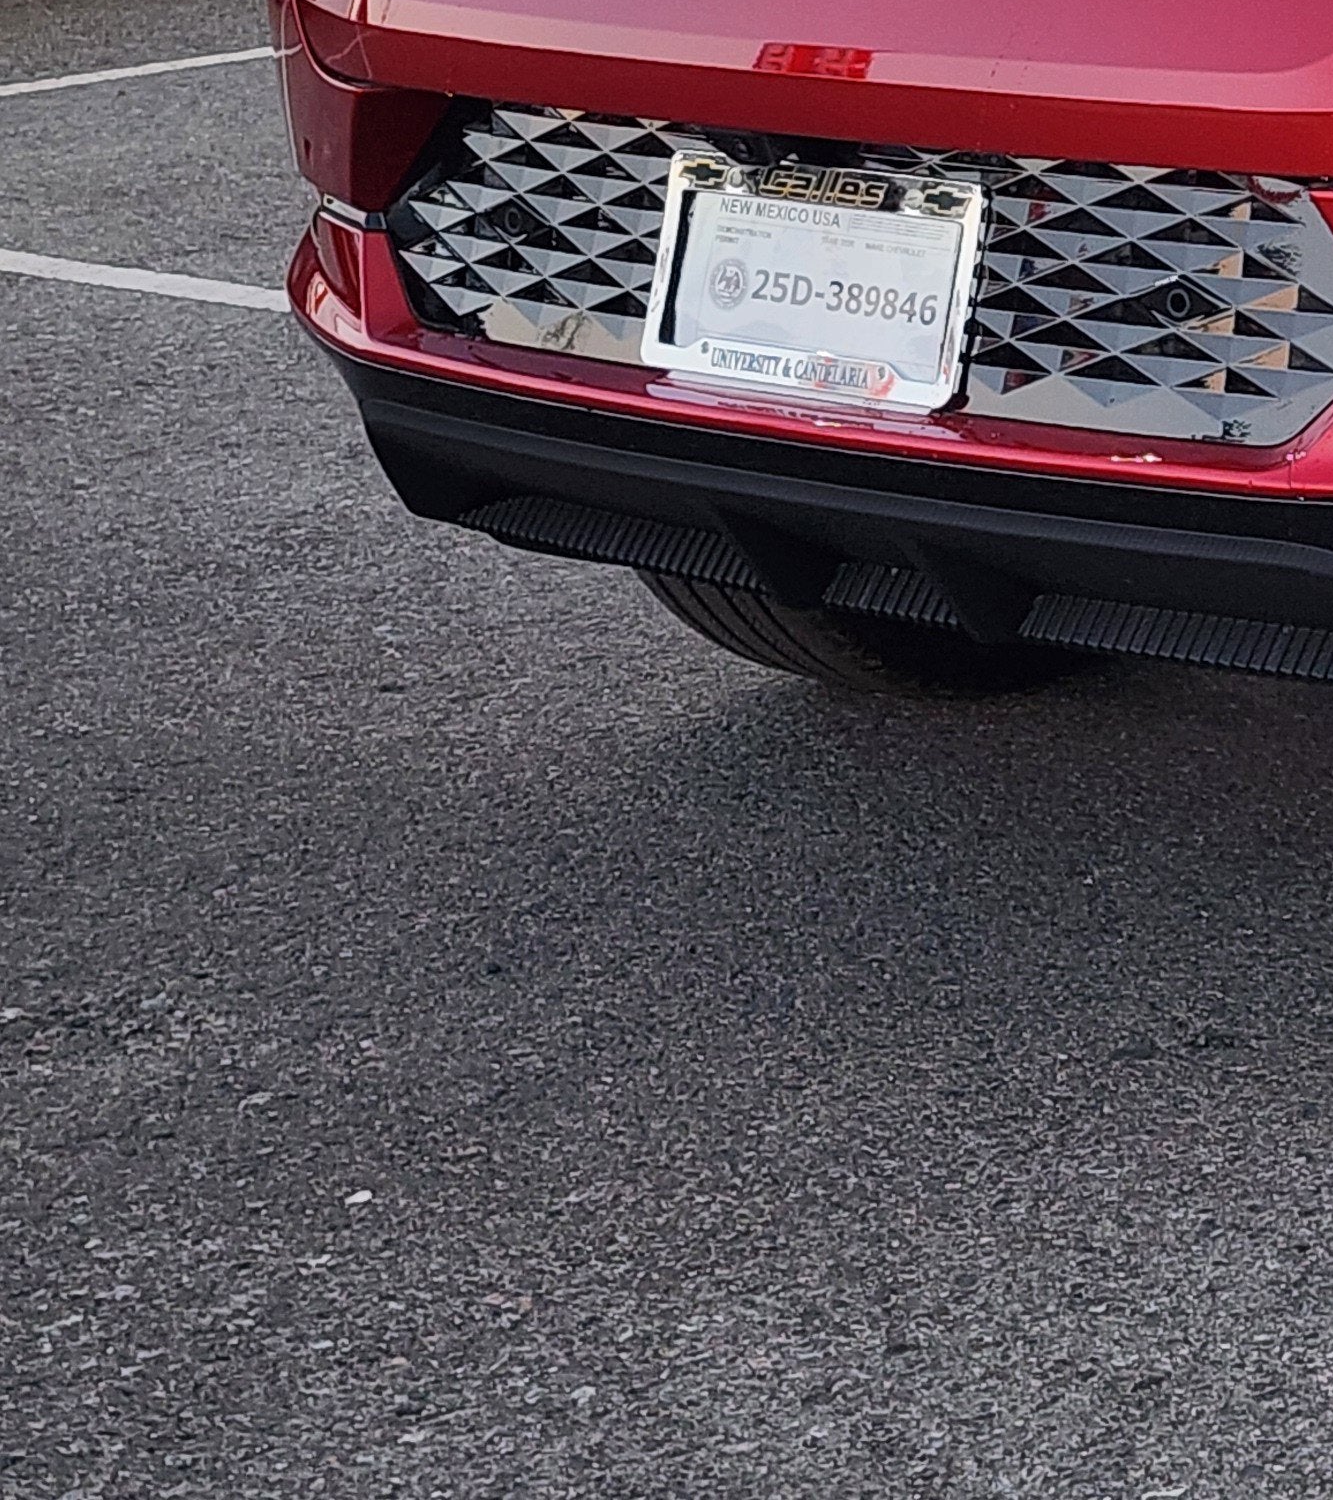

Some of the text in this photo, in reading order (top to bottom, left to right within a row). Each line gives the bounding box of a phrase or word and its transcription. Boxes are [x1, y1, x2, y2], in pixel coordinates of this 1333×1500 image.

[759, 165, 889, 209] Galles
[720, 198, 753, 216] NEW
[755, 202, 809, 224] MEXICO
[812, 210, 841, 229] USA
[751, 268, 939, 326] 25D-389846
[711, 347, 782, 377] UNIVERSITY
[782, 358, 791, 379] &
